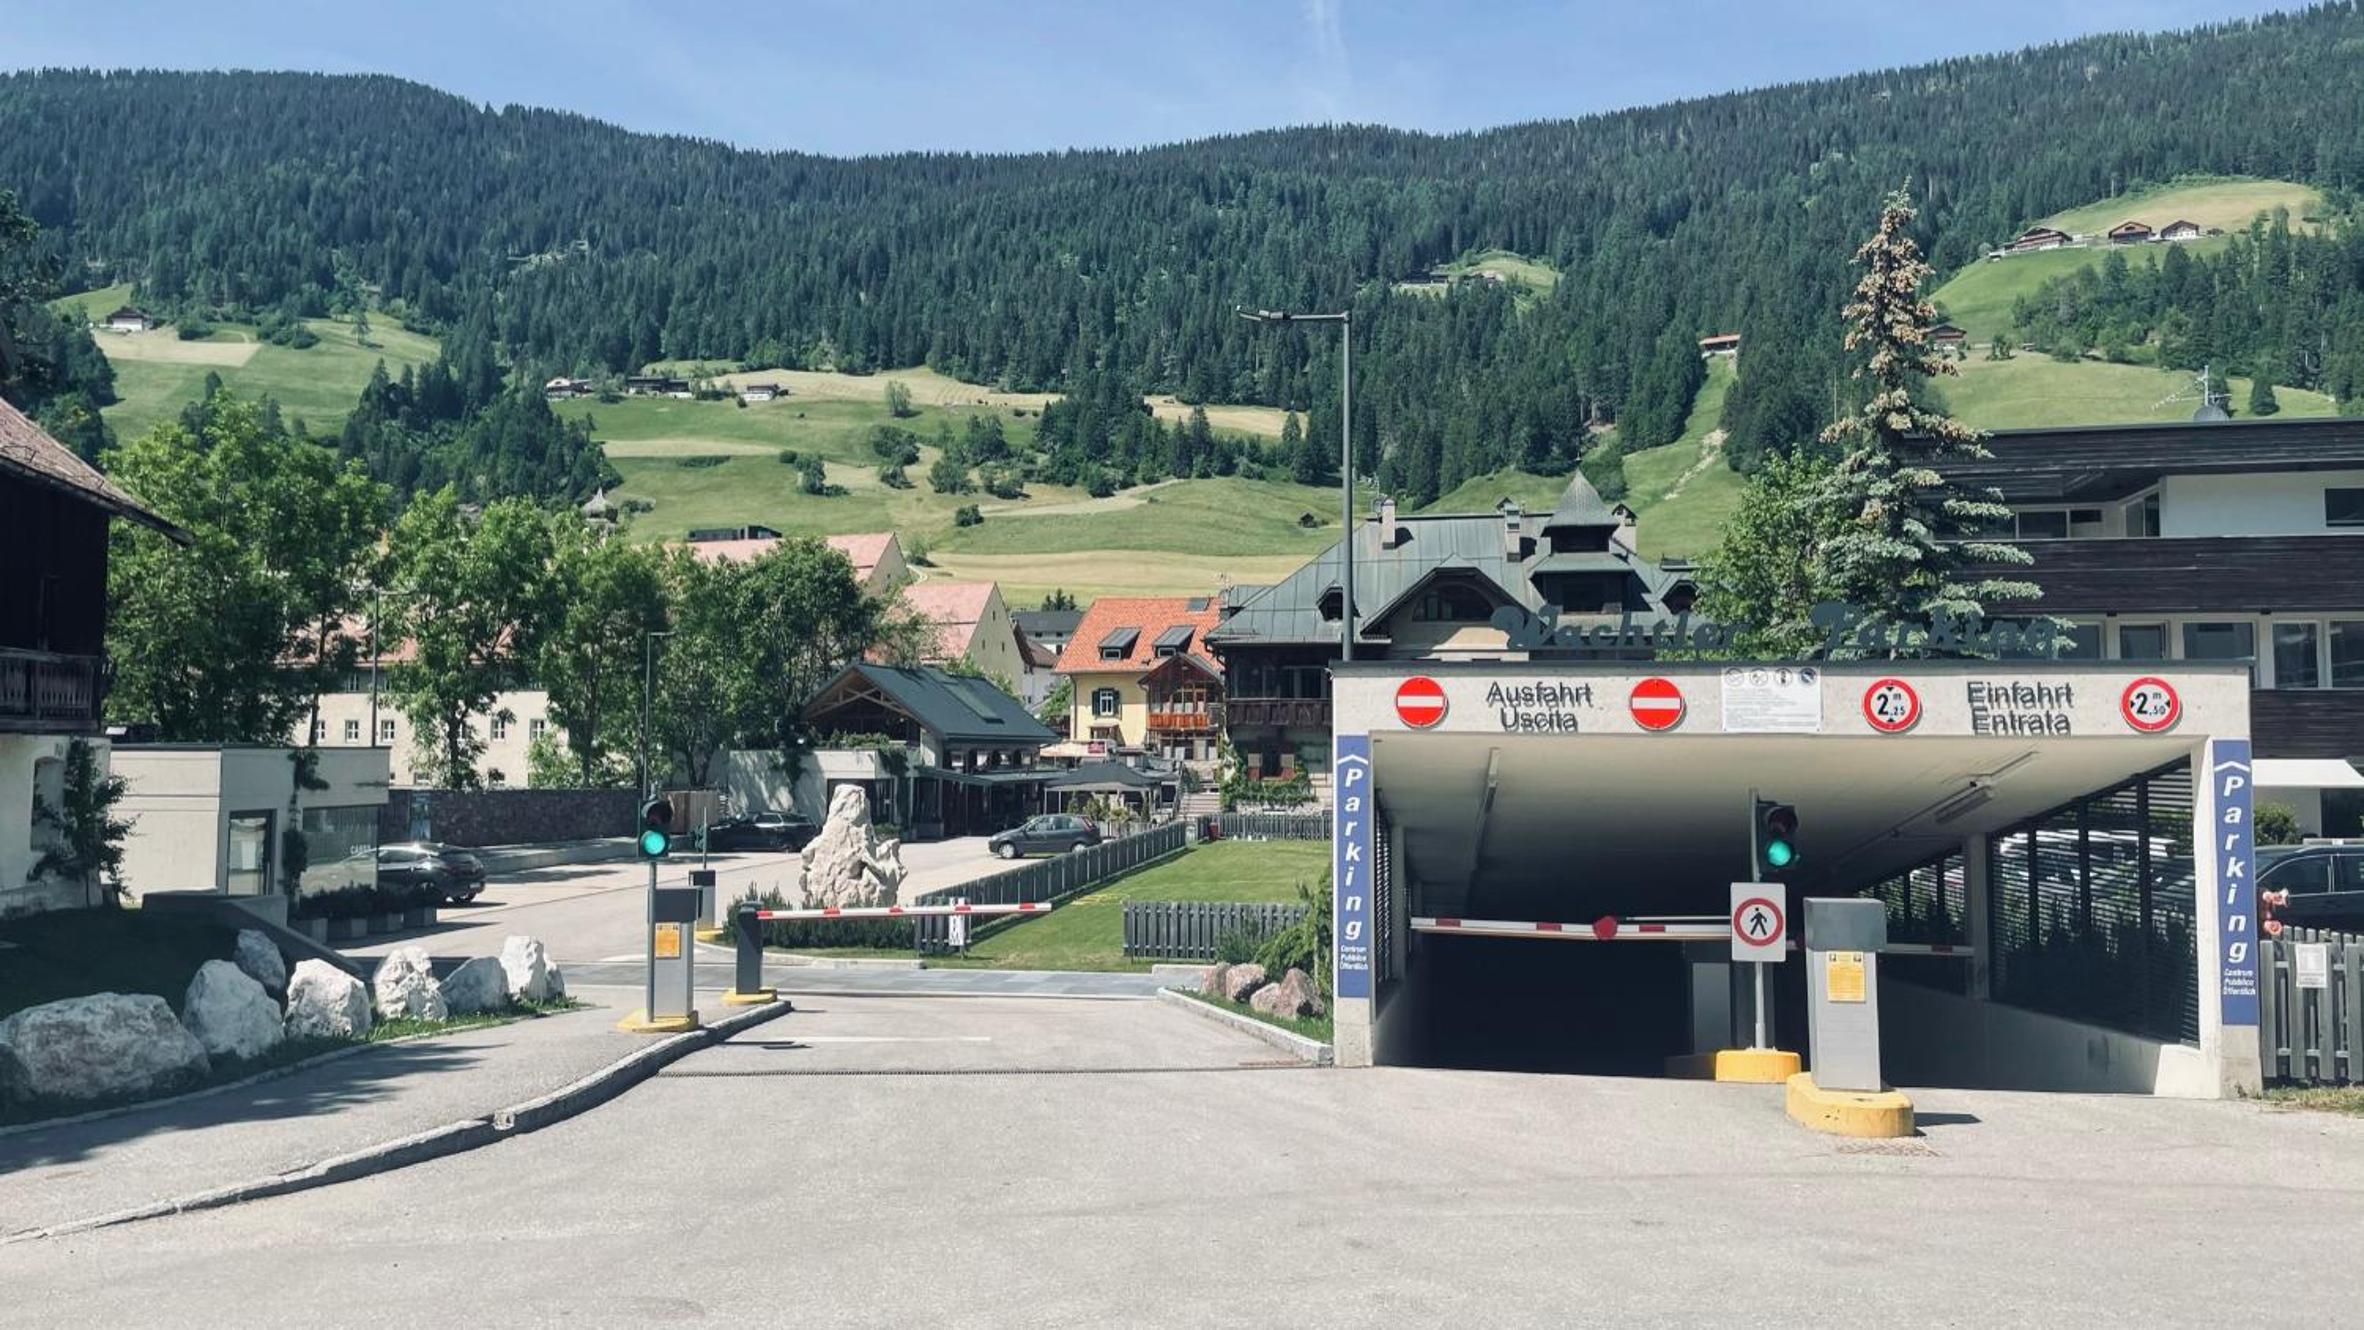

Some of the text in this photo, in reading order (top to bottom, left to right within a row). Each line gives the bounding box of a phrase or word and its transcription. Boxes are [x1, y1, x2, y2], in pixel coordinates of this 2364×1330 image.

[1486, 681, 1592, 706] Ausfahrt
[1967, 681, 2073, 705] Einfahrt
[1501, 707, 1578, 731] Uscita
[1971, 707, 2071, 732] Entrata
[1344, 768, 1363, 940] Parking
[2223, 775, 2248, 964] Parking
